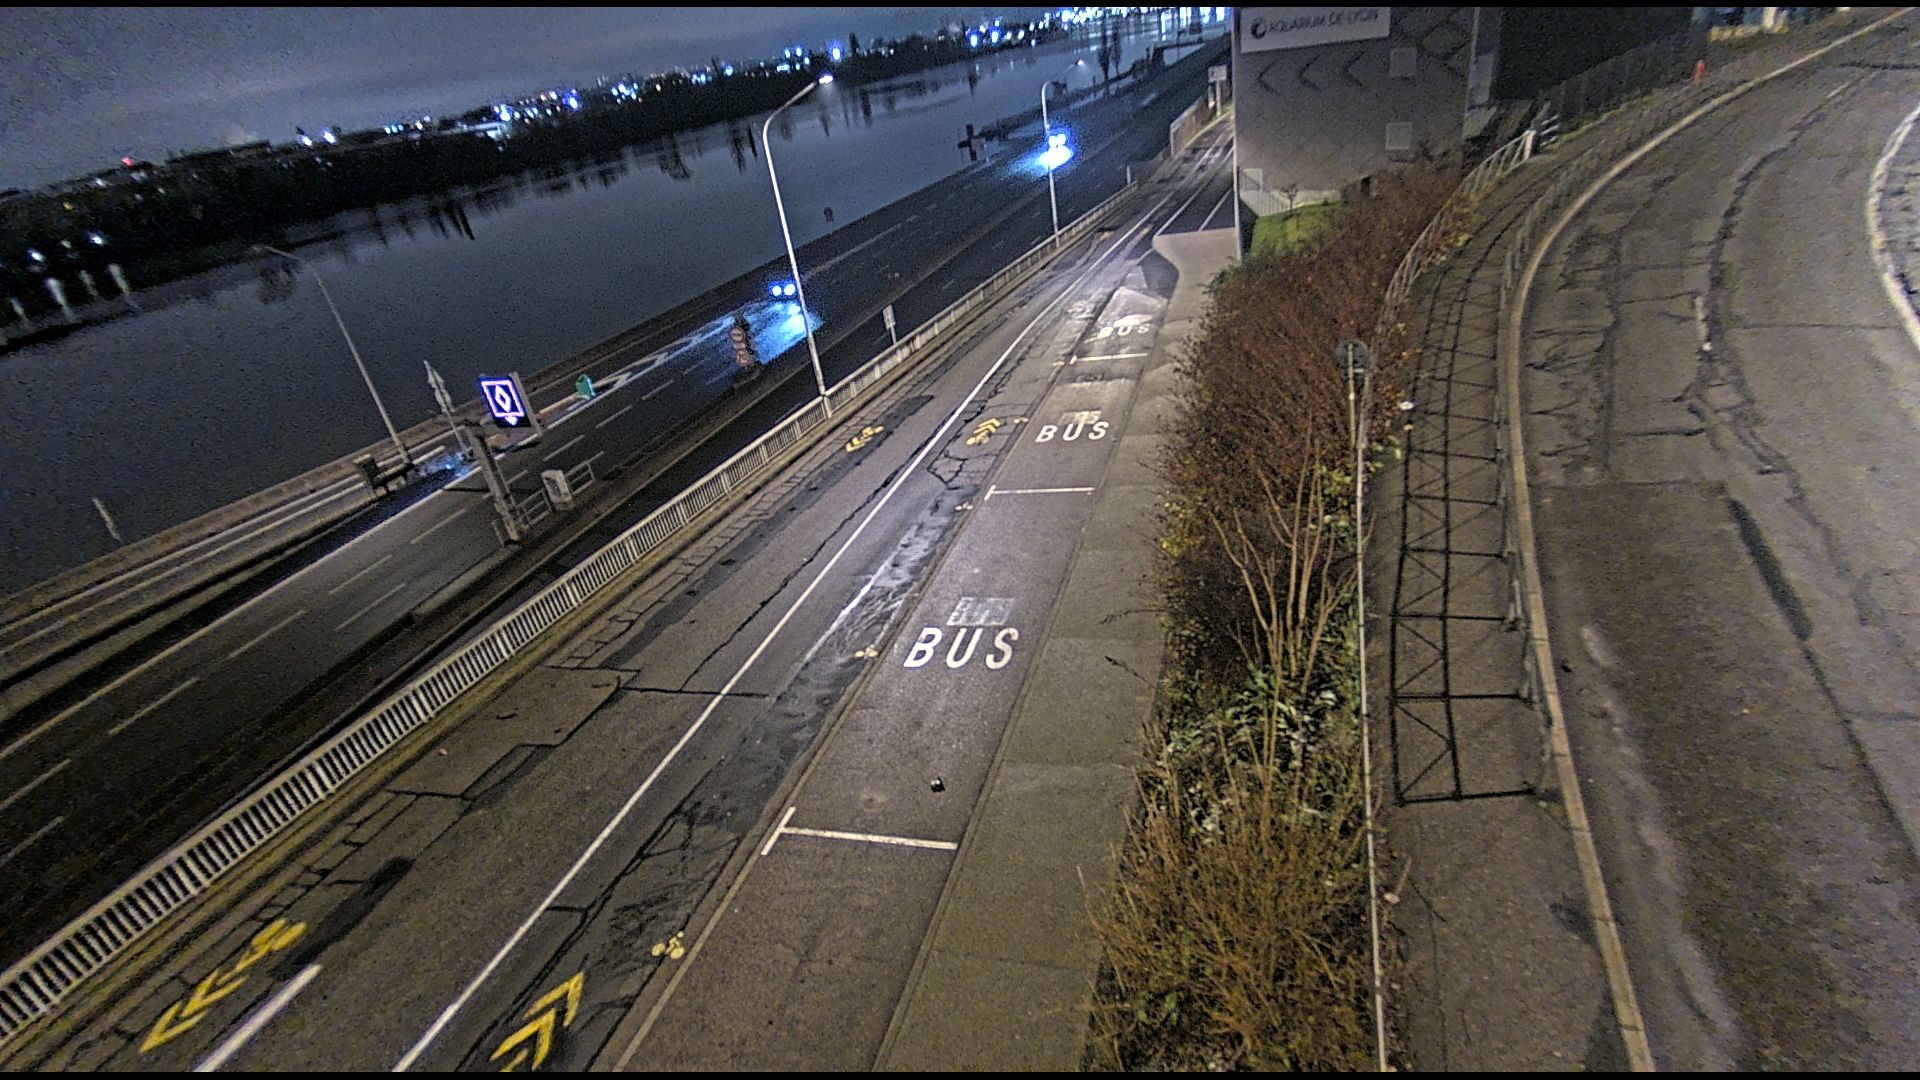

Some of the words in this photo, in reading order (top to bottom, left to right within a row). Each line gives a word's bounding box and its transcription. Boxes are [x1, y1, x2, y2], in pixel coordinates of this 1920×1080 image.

[1268, 15, 1326, 32] AQUARIUM
[1328, 10, 1344, 26] DE
[1097, 323, 1151, 339] BUS
[1035, 421, 1109, 443] BUS
[903, 627, 1019, 670] BUS
